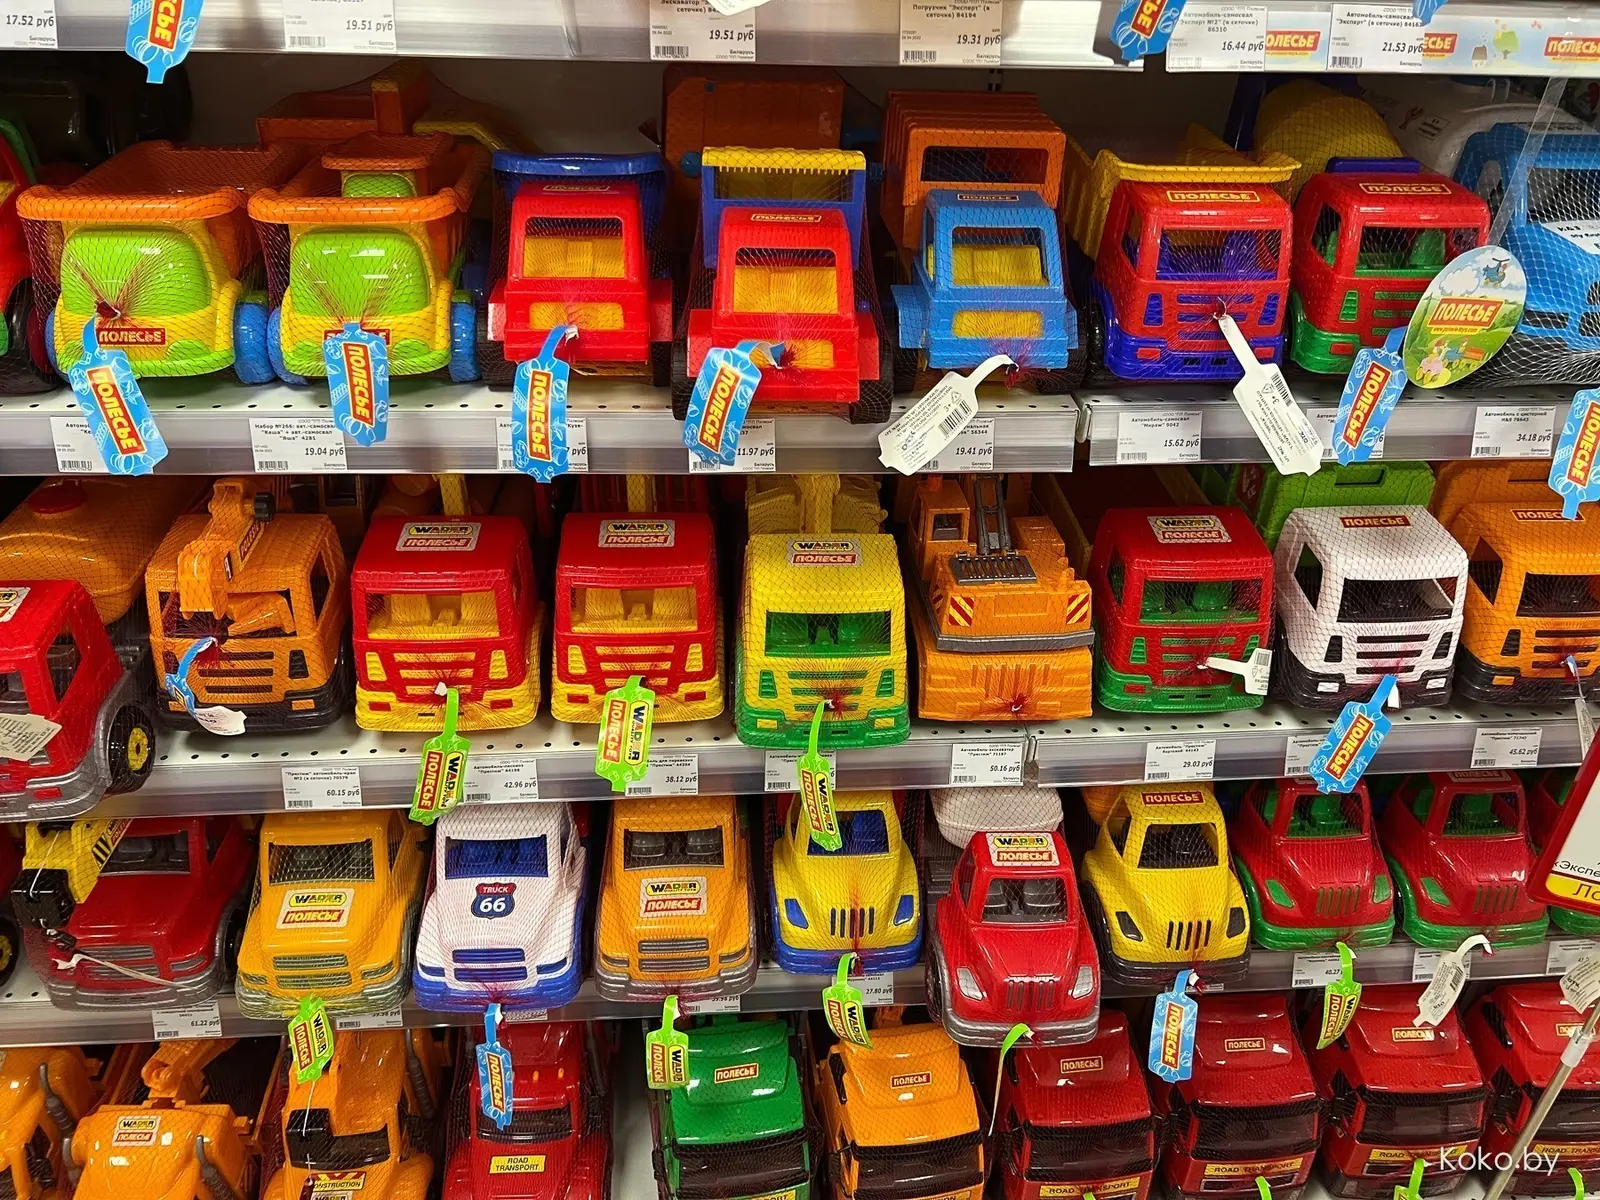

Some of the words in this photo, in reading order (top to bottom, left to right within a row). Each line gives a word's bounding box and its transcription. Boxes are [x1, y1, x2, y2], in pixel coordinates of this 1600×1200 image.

[6, 15, 34, 27] 17.52
[36, 15, 55, 28] руб
[155, 0, 176, 42] СЬЕ
[1346, 12, 1414, 20] Автомобиль-самосвал
[346, 20, 372, 30] 19.51
[376, 20, 393, 31] руб
[709, 30, 734, 40] 19.51
[737, 30, 754, 41] руб
[957, 35, 981, 45] 19.31
[984, 35, 1000, 46] руб
[1266, 33, 1316, 48] ОЛЕСЬЕ
[1222, 41, 1246, 51] 16.44
[1248, 40, 1264, 52] руб
[1382, 42, 1406, 53] 21.53
[1408, 43, 1424, 53] руб
[1548, 40, 1600, 55] ПОЛЕСЬ
[1433, 303, 1496, 322] ПОЛЕСЬЕ
[99, 331, 162, 343] ПОЛЕСЬЕ
[347, 344, 370, 419] ПОЛЕСЬЕ
[91, 371, 138, 450] ПОЛЕСЬЕ
[701, 367, 737, 450] ПОЛЕСЬЕ
[1349, 367, 1385, 442] ПОЛЕСЬЕ
[532, 373, 550, 454] ПОЛЕСЬЕ
[1164, 439, 1184, 447] 15.62
[1186, 438, 1199, 447] руб
[1538, 433, 1551, 442] руб
[1571, 404, 1600, 481] ПОЛЕСЬЕ
[305, 447, 327, 455] 19.04
[330, 447, 344, 456] руб
[572, 447, 586, 455] руб
[737, 447, 758, 455] 11.97
[760, 447, 774, 456] руб
[955, 447, 976, 455] 19.41
[978, 447, 992, 455] руб
[1344, 518, 1404, 526] ПОЛЕСЬЕ
[606, 701, 624, 757] ПОЛЕСЬЕ
[631, 706, 645, 760] WADER
[1330, 718, 1369, 774] ПОЛЕСЬЕ
[420, 753, 440, 807] ПОЛЕСЬЕ
[446, 756, 461, 799] WADE
[347, 789, 360, 797] руб
[1146, 794, 1200, 803] ПОЛЕСЬЕ
[803, 772, 820, 830] ПОЛЕСЬЕ
[818, 777, 834, 831] WADER
[650, 883, 696, 892] WADER
[294, 894, 342, 904] WADER
[480, 897, 506, 912] 66
[647, 899, 698, 911] ПОЛЕСЬЕ
[285, 911, 341, 922] ПОЛЕСЬЕ
[1326, 996, 1340, 1038] ПОЛЕСЬЕ
[314, 1014, 328, 1055] WADER
[1165, 1004, 1181, 1065] ПОЛЕСЬЕ
[295, 1025, 310, 1068] ПОЛЕСЬЕ
[1228, 1041, 1261, 1049] ПОЛЕСЬЕ
[653, 1045, 664, 1082] ПОЛЕСЬЕ
[1063, 1060, 1100, 1070] ПОЛЕСЬЕ
[717, 1066, 755, 1080] ПОЛЕСЬЕ
[490, 1056, 502, 1109] ПОЛЕСЬЕ
[894, 1074, 928, 1086] ПОЛЕСЬЕ
[118, 1133, 150, 1141] ПОЛЕСЬЕ
[495, 1163, 539, 1171] TRANSPORT
[508, 1157, 528, 1165] ROAD
